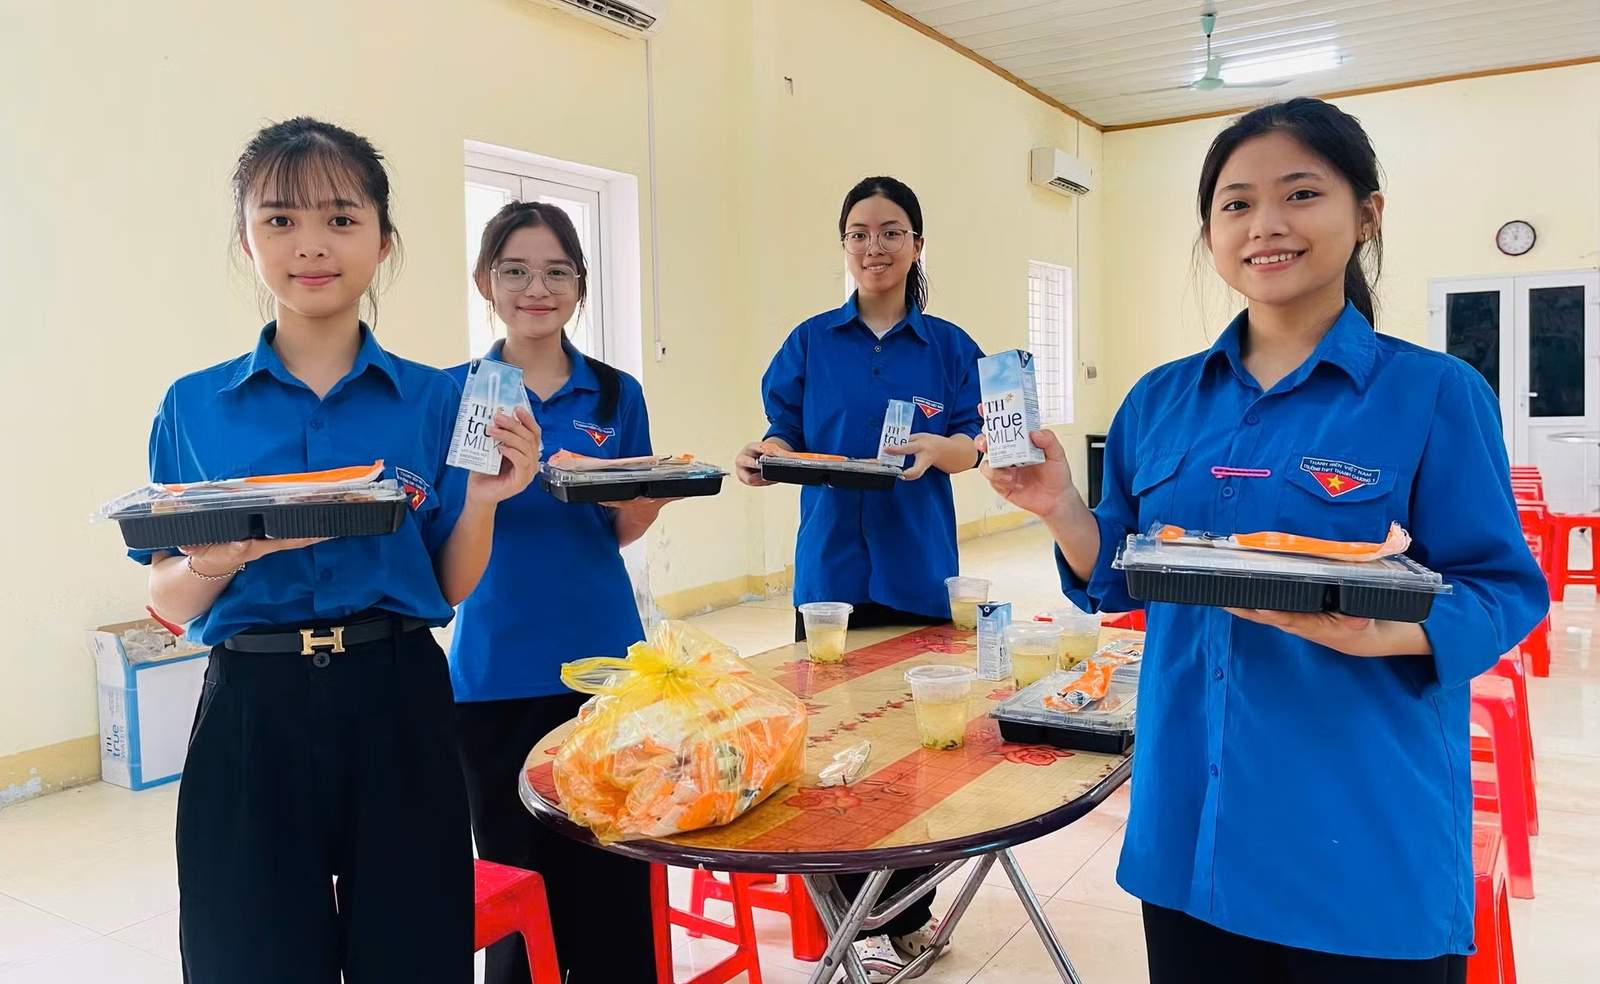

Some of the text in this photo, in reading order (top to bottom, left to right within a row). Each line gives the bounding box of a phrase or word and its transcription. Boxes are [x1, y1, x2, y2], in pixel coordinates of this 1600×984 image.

[468, 416, 491, 437] tru
[986, 412, 1022, 431] true
[884, 434, 908, 446] true
[988, 425, 1025, 446] MILK
[112, 724, 121, 758] true
